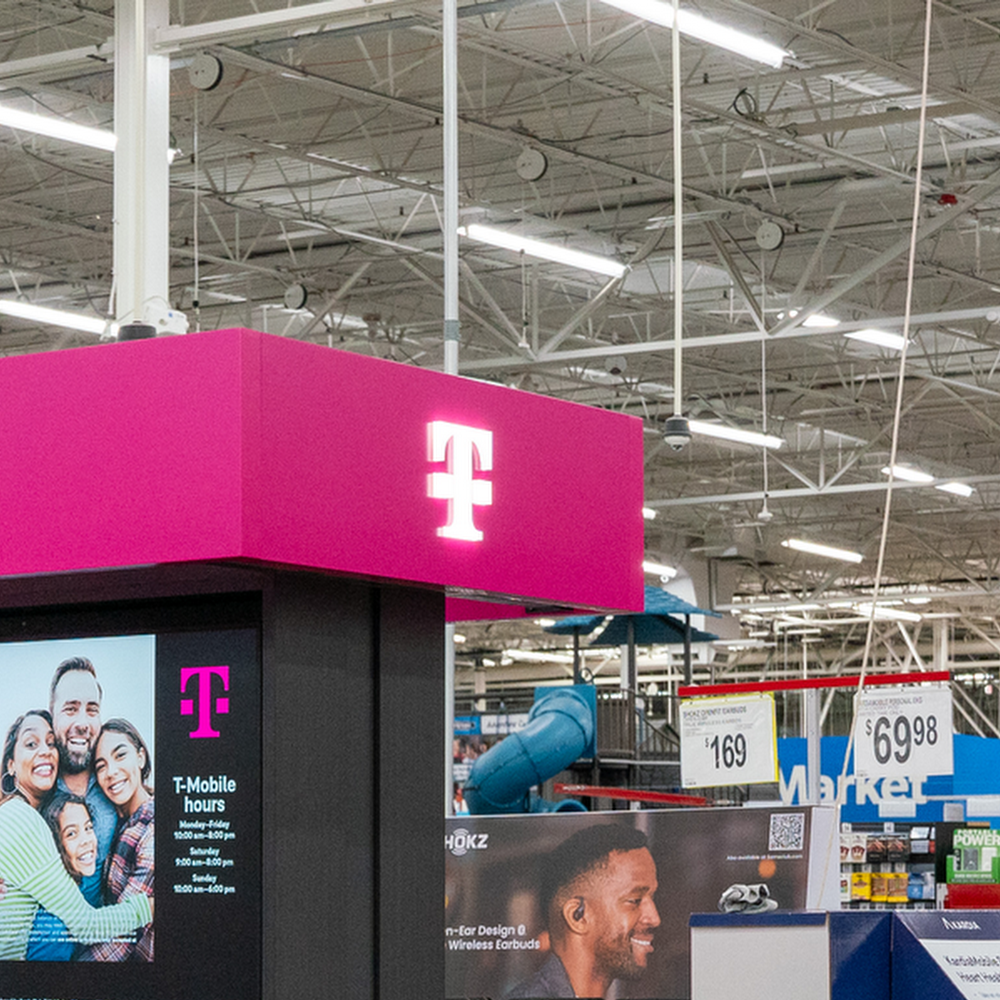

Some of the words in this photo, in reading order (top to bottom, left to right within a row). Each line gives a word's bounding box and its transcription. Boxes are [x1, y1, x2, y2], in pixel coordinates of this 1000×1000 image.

[426, 420, 493, 541] T
[180, 666, 229, 738] T
[722, 705, 747, 714] EARBUDS
[705, 733, 747, 769] $169
[173, 774, 237, 794] T-Mobile
[779, 764, 928, 806] Market
[184, 796, 226, 813] hours
[173, 831, 193, 840] 10:00
[445, 833, 489, 849] HOKZ
[953, 834, 1000, 847] POWER
[189, 847, 220, 857] Saturday
[175, 858, 191, 867] 9:00
[192, 873, 217, 884] Sunday
[173, 885, 193, 894] 10:00
[445, 925, 476, 937] n-Ear
[478, 923, 516, 939] Design
[448, 939, 493, 950] Wireless
[495, 938, 541, 950] Earbuds
